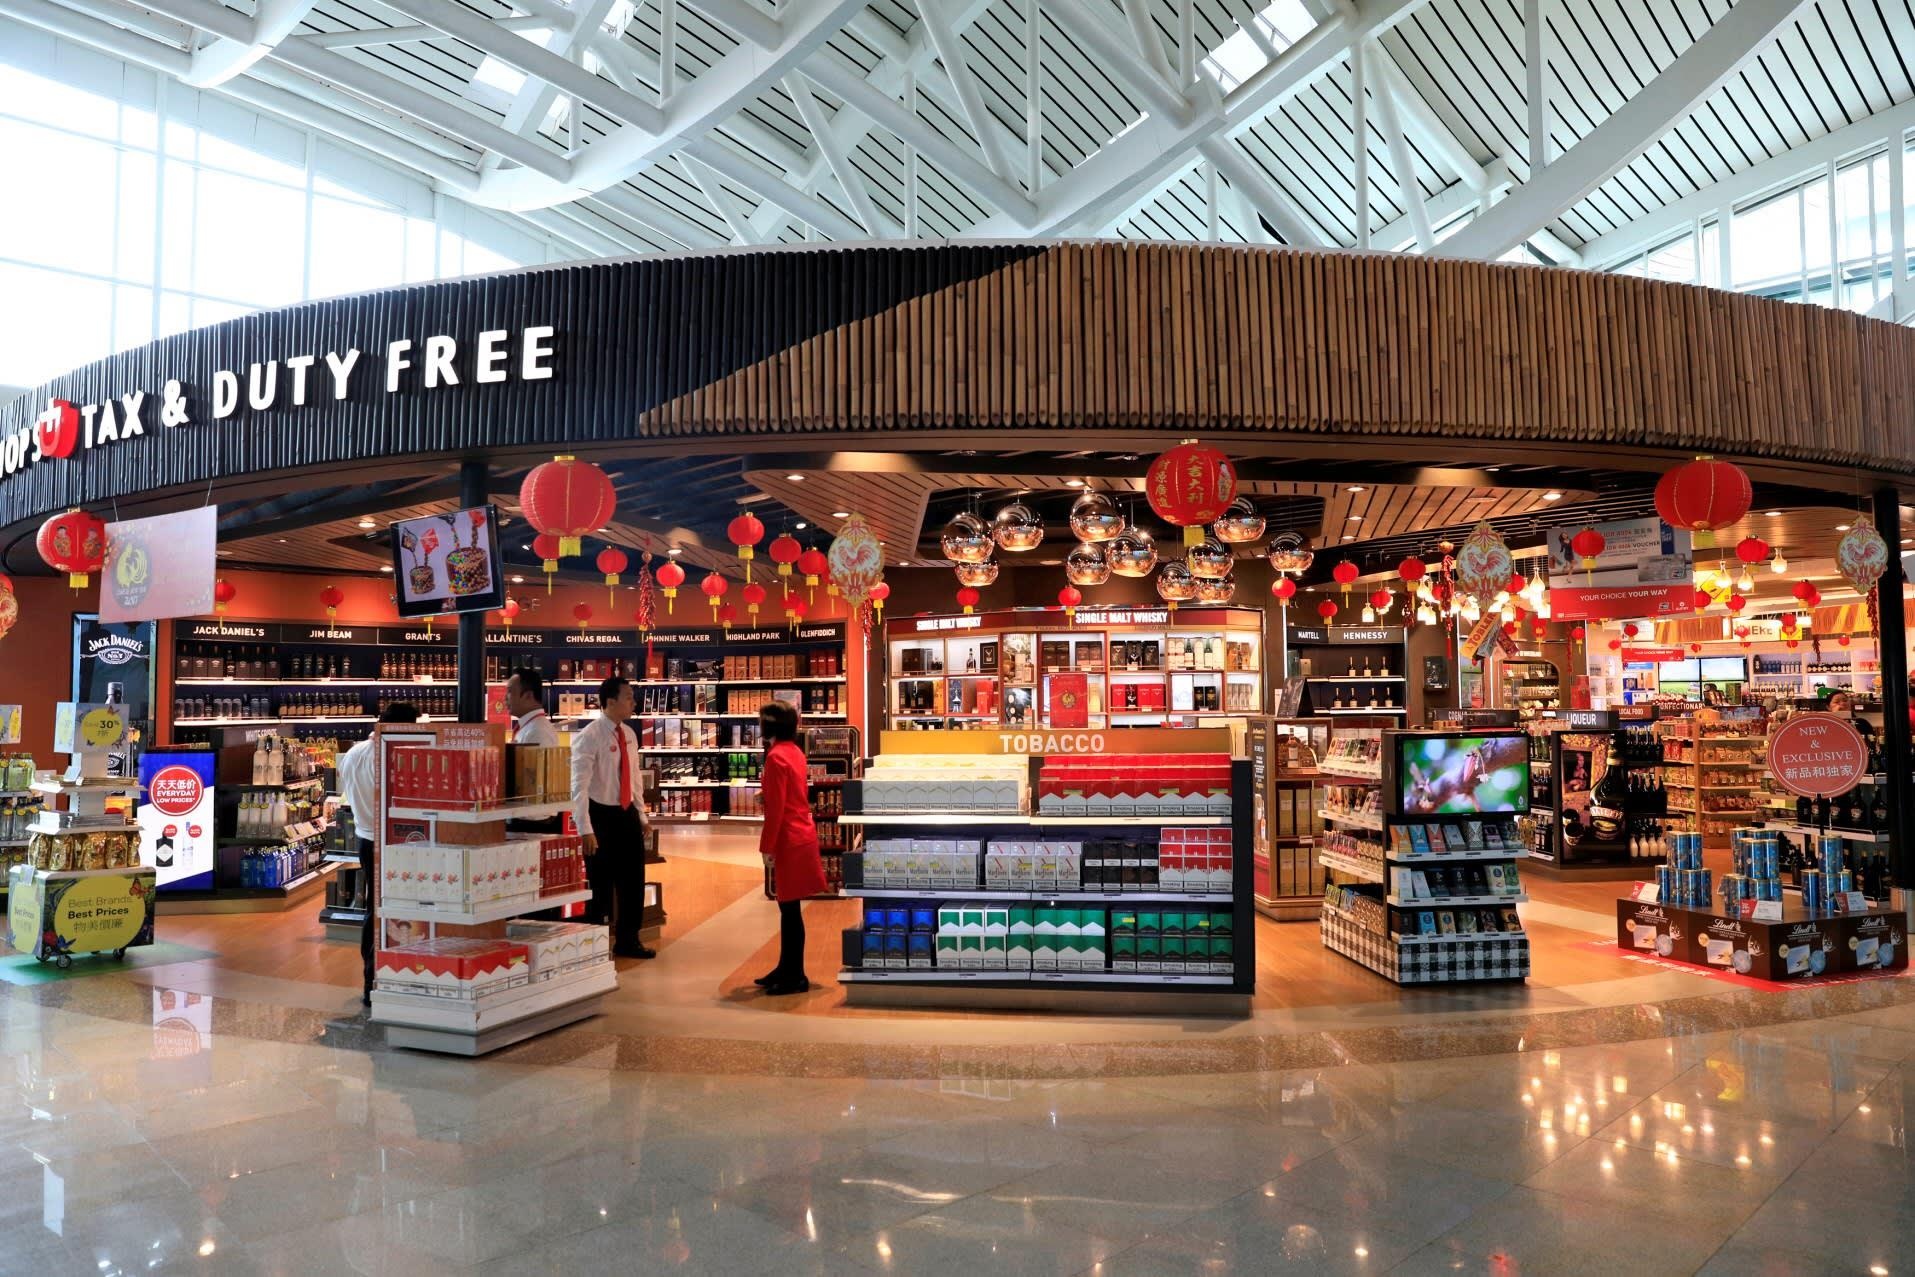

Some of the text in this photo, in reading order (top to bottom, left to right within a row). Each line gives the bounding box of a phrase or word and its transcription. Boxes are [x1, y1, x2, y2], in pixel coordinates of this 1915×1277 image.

[82, 390, 145, 448] TAX
[162, 380, 190, 427] &
[213, 348, 360, 418] DUTY
[387, 326, 554, 393] FREE
[1601, 592, 1627, 600] CHOICE
[1075, 612, 1108, 624] SINGLE
[194, 626, 265, 636] JACK DANIEL'S
[310, 630, 352, 639] JIM BEAM
[800, 628, 836, 638] GLENFIDDICH
[1298, 631, 1320, 640] MARTELL
[1343, 632, 1388, 640] HENNESSY
[405, 632, 441, 641] GRANT'S
[566, 635, 622, 643] CHIVAS REGAL
[678, 634, 710, 642] WALKER
[88, 634, 144, 652] JACK DANIEL'S
[1566, 713, 1597, 726] LIQUEUR
[1800, 726, 1828, 736] NEW
[1000, 734, 1105, 753] TOBACCO
[1810, 740, 1820, 749] &
[1782, 750, 1854, 764] EXCLUSIVE
[1785, 764, 1854, 780] 新品和独家
[156, 778, 196, 790] 天天低价
[68, 906, 129, 920] Best Prices
